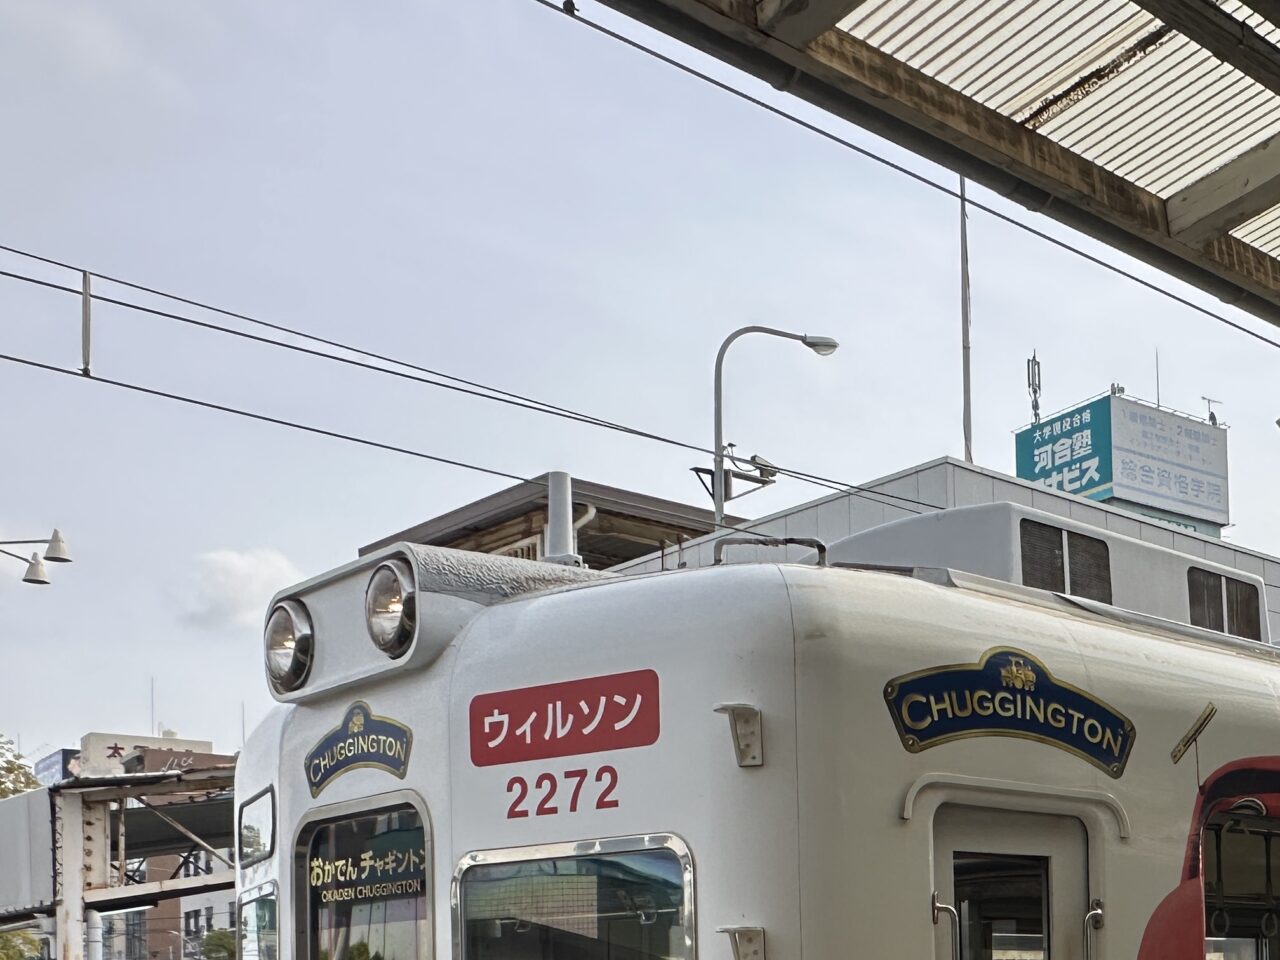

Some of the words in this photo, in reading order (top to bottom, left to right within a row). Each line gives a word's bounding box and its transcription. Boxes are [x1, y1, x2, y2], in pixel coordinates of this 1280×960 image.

[1033, 429, 1093, 474] 河合塾
[483, 692, 643, 748] ウィルソン
[902, 690, 1122, 757] CHUGGINGTON
[309, 736, 406, 784] CHUGGINGTON
[506, 765, 620, 819] 2272
[310, 857, 358, 887] おかでん
[321, 887, 355, 903] OKADEN
[356, 878, 421, 899] CHUGGINGTON
